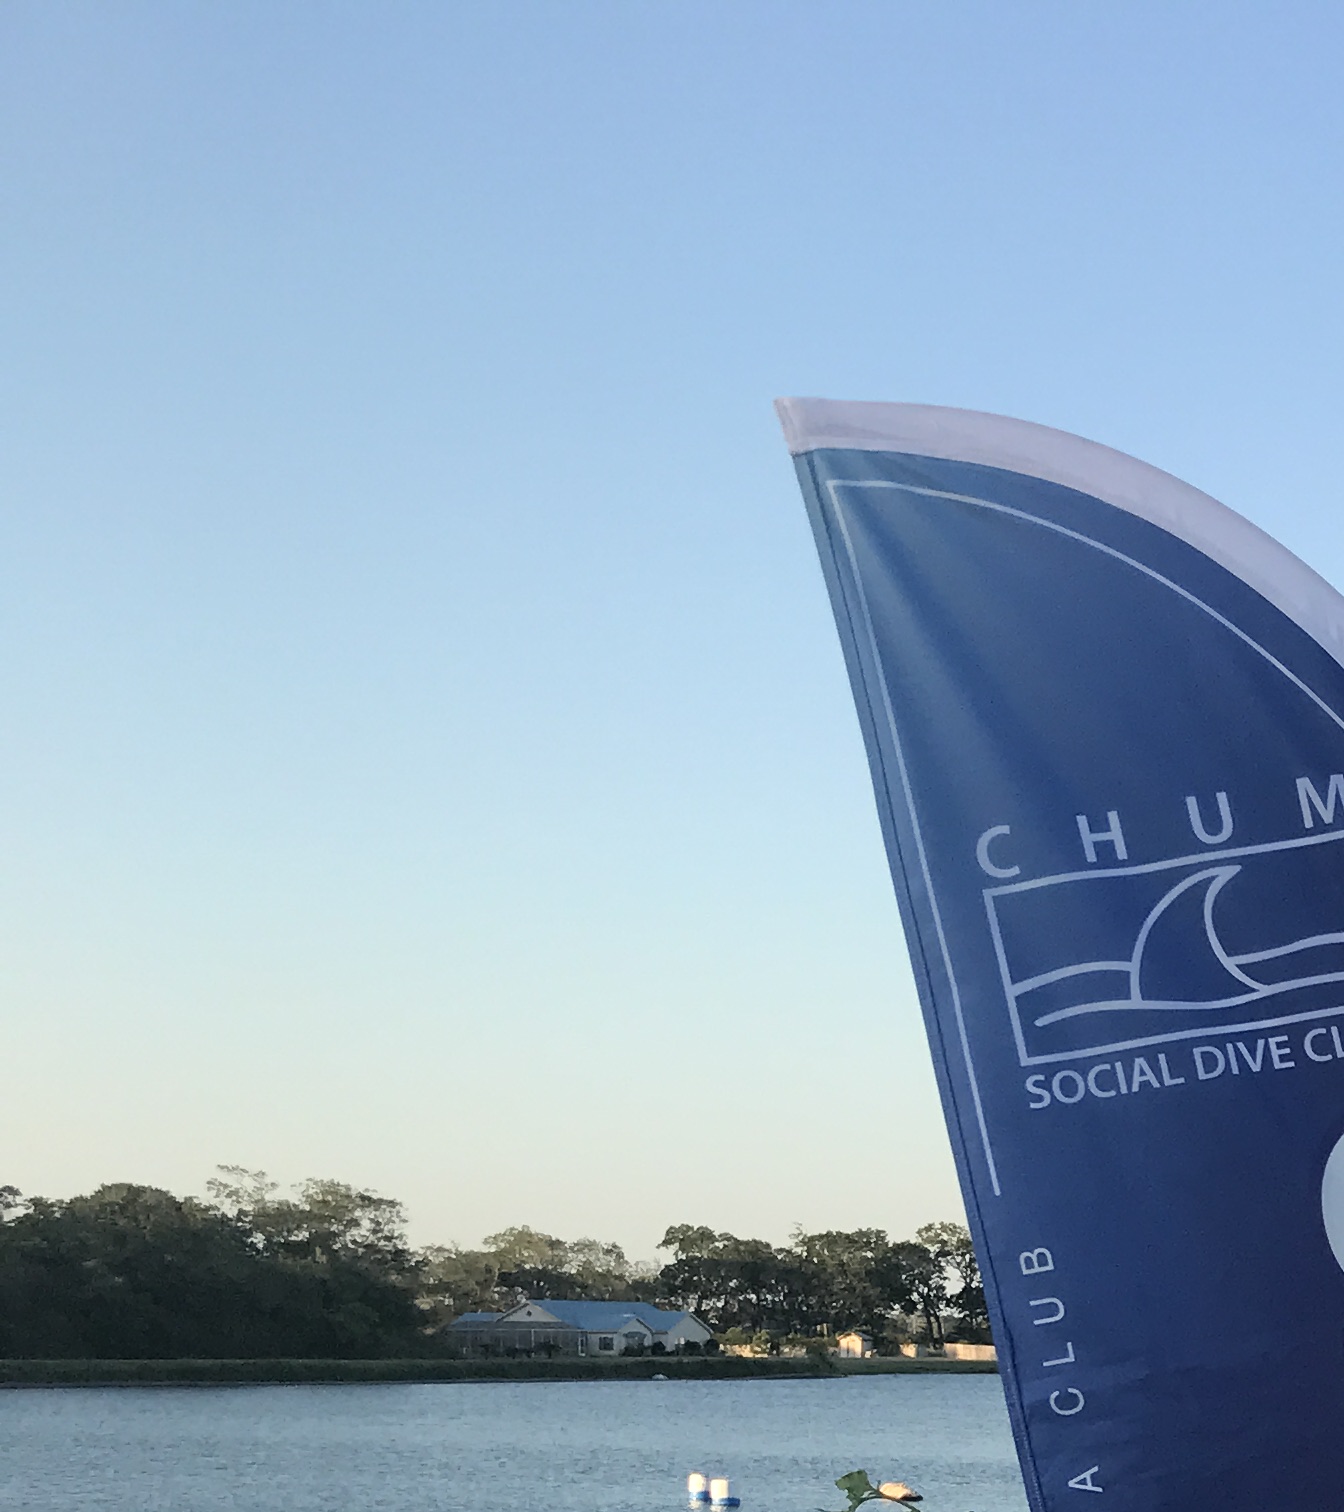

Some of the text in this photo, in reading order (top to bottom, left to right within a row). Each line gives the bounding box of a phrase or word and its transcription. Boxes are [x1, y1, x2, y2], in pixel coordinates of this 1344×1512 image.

[1024, 1053, 1186, 1110] SOCIAL
[1191, 1034, 1295, 1082] DIVE
[1018, 1246, 1085, 1416] CLUB
